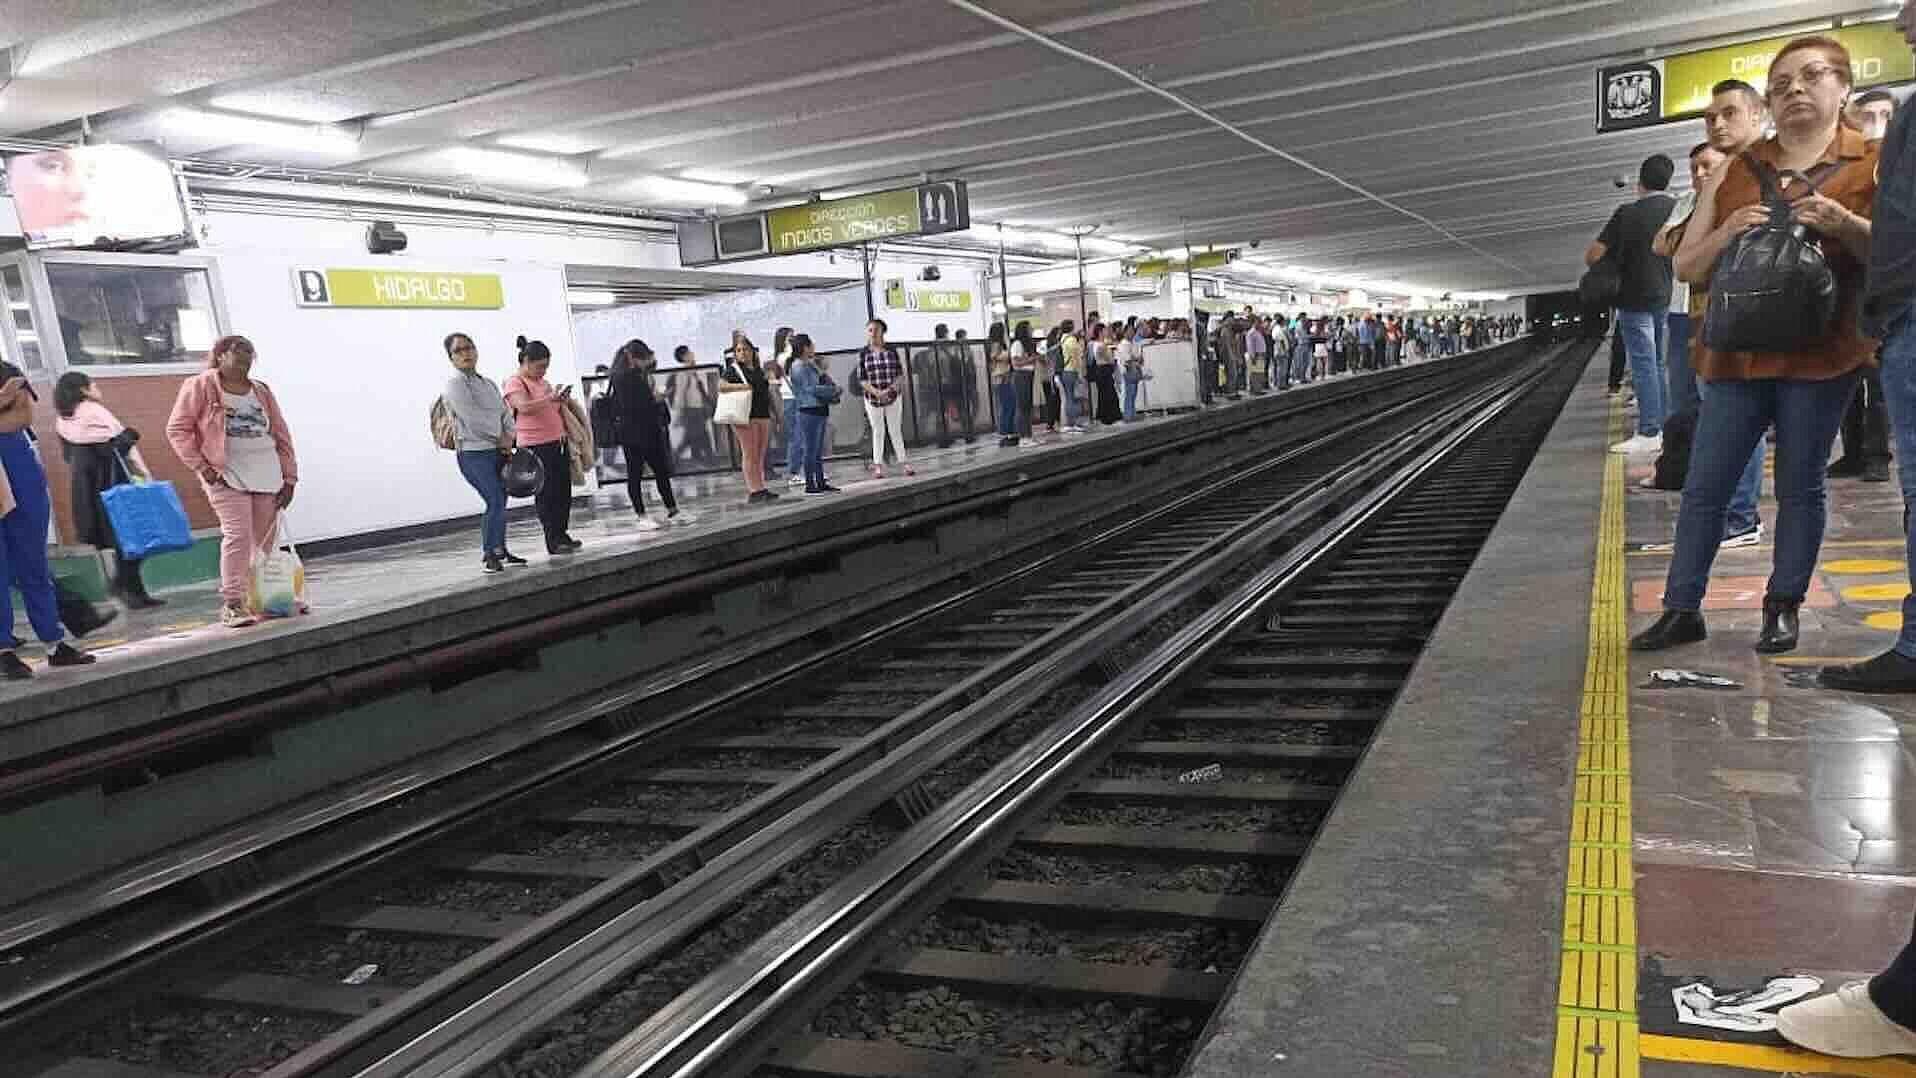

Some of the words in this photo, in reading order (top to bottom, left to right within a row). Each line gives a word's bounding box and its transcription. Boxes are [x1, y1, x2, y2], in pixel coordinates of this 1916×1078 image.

[781, 227, 833, 248] INDIOS
[841, 215, 908, 239] VERDES
[372, 274, 465, 301] HIDALGO
